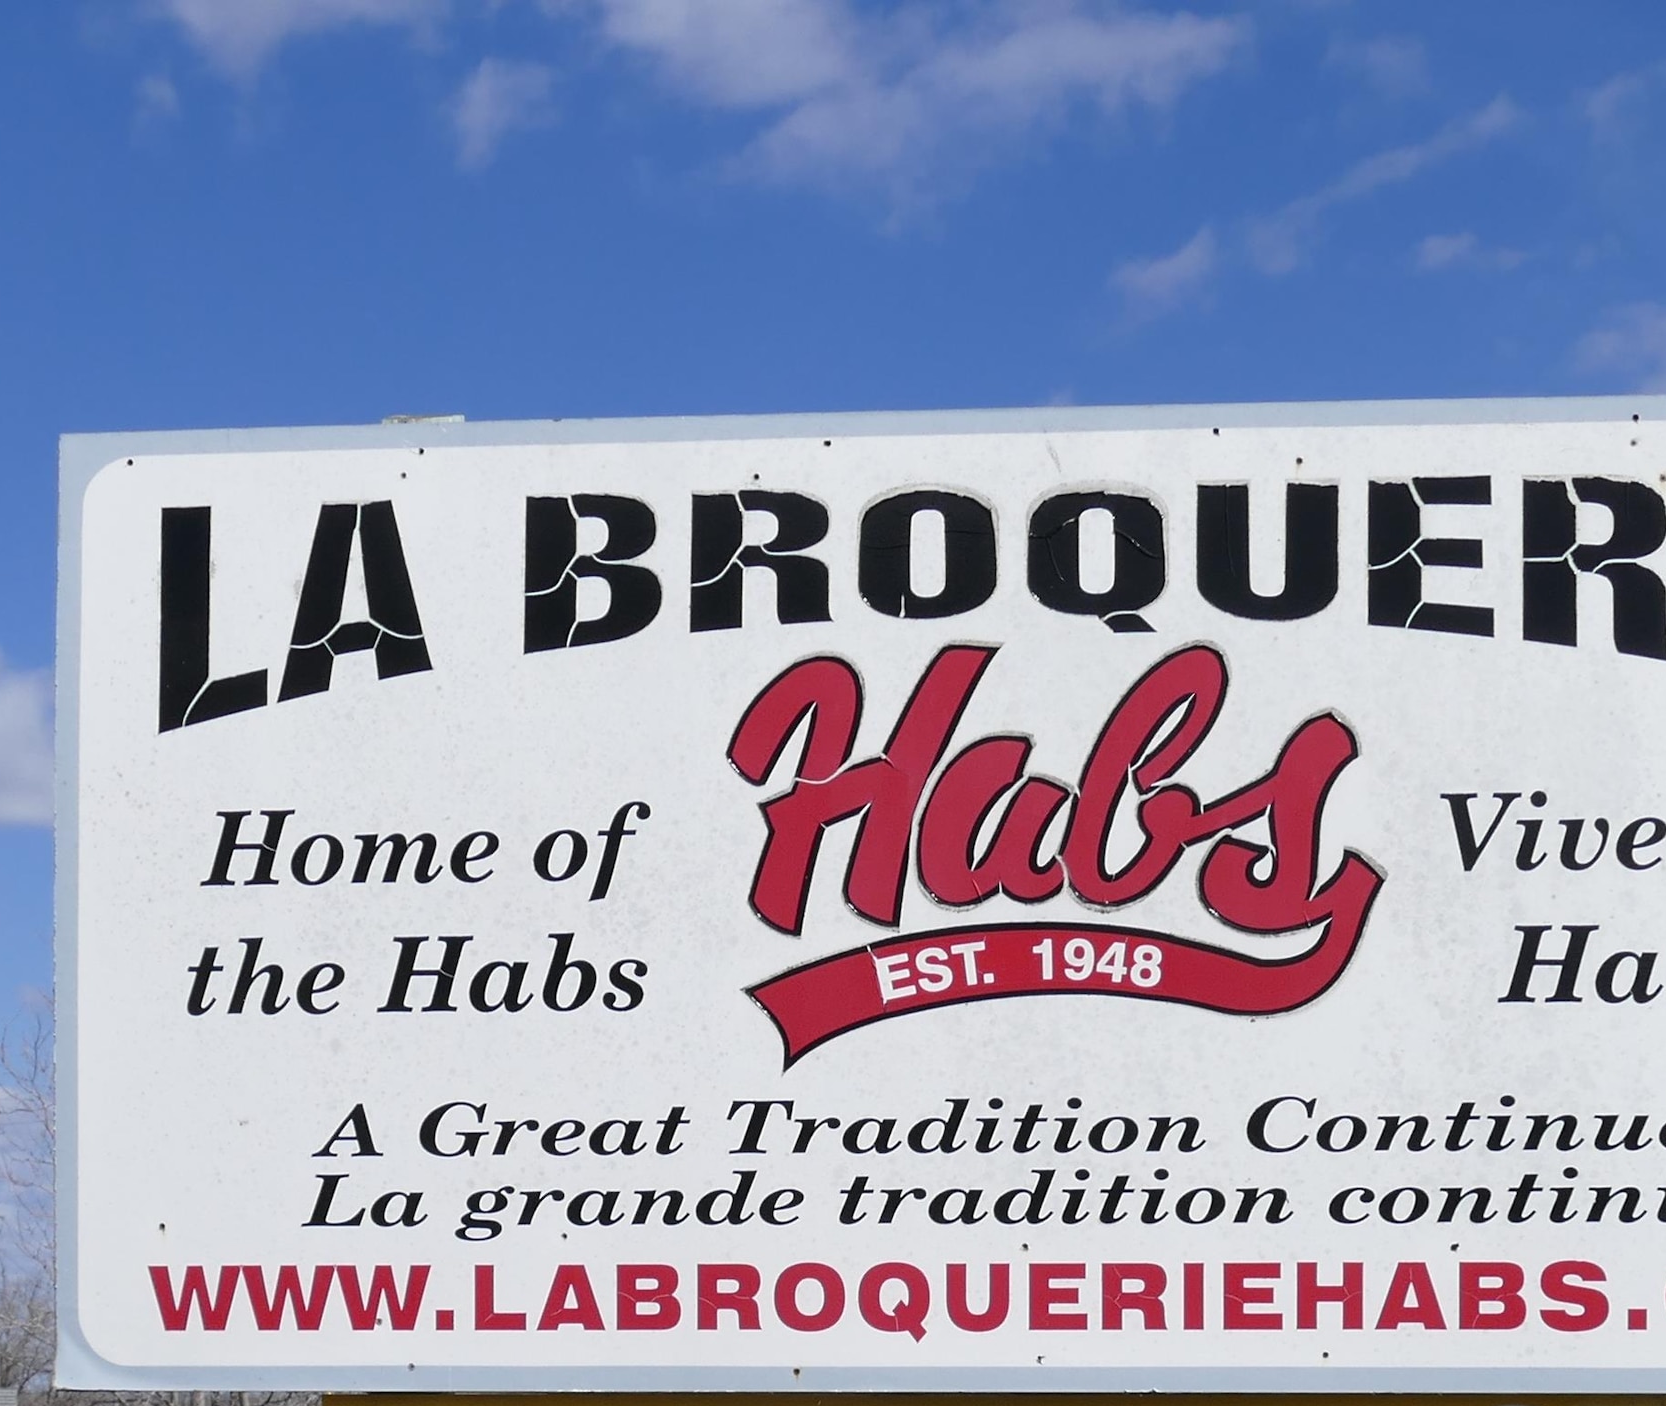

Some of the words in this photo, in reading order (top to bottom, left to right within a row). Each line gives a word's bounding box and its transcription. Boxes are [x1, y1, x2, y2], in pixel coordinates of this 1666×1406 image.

[157, 498, 434, 735] LA
[726, 638, 1365, 938] Habs
[199, 808, 500, 887] Home
[532, 800, 652, 902] of
[186, 936, 346, 1017] the
[376, 931, 649, 1014] Habs
[873, 939, 997, 1003] EST.
[1030, 936, 1165, 990] 1948
[310, 1102, 385, 1158] A
[418, 1101, 692, 1158] Great
[726, 1096, 1207, 1155] Tradition
[300, 1173, 429, 1228] La
[454, 1169, 805, 1242] grande
[838, 1167, 1295, 1226] tradition
